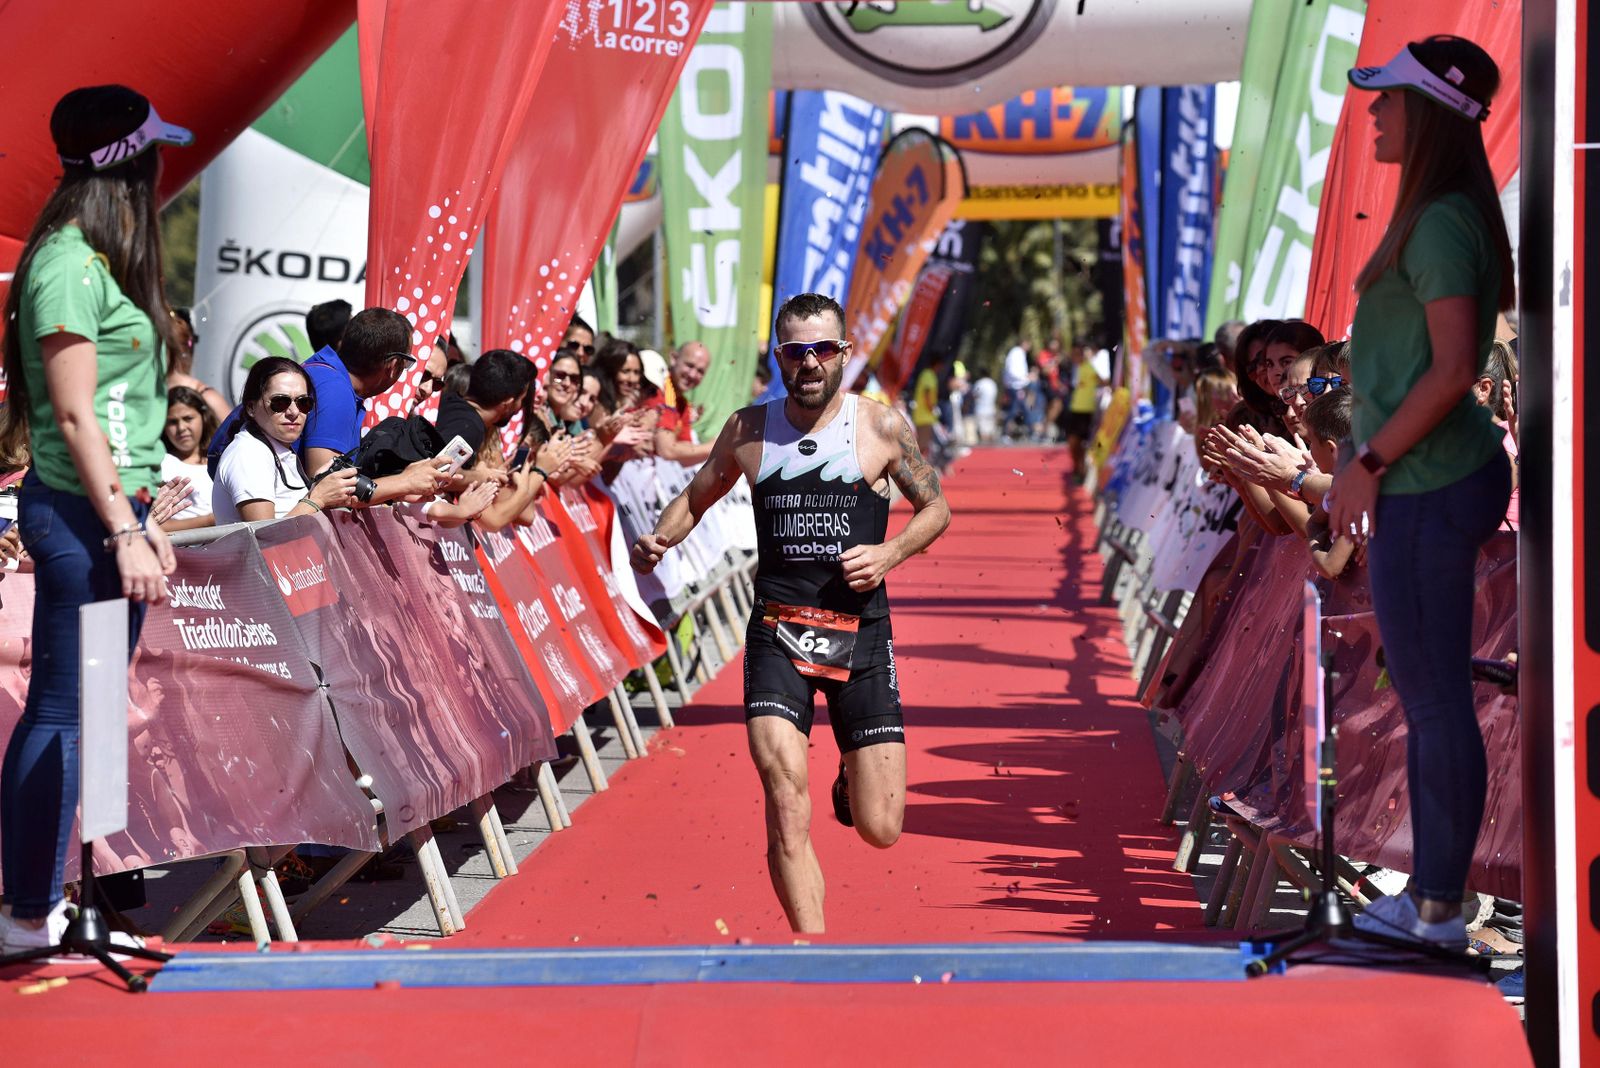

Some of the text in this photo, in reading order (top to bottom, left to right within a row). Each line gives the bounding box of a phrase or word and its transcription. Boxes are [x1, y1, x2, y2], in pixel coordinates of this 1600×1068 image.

[765, 494, 801, 509] UTRERA
[773, 512, 851, 537] LUMBRERAS
[782, 541, 842, 554] mobel
[798, 630, 830, 655] 62
